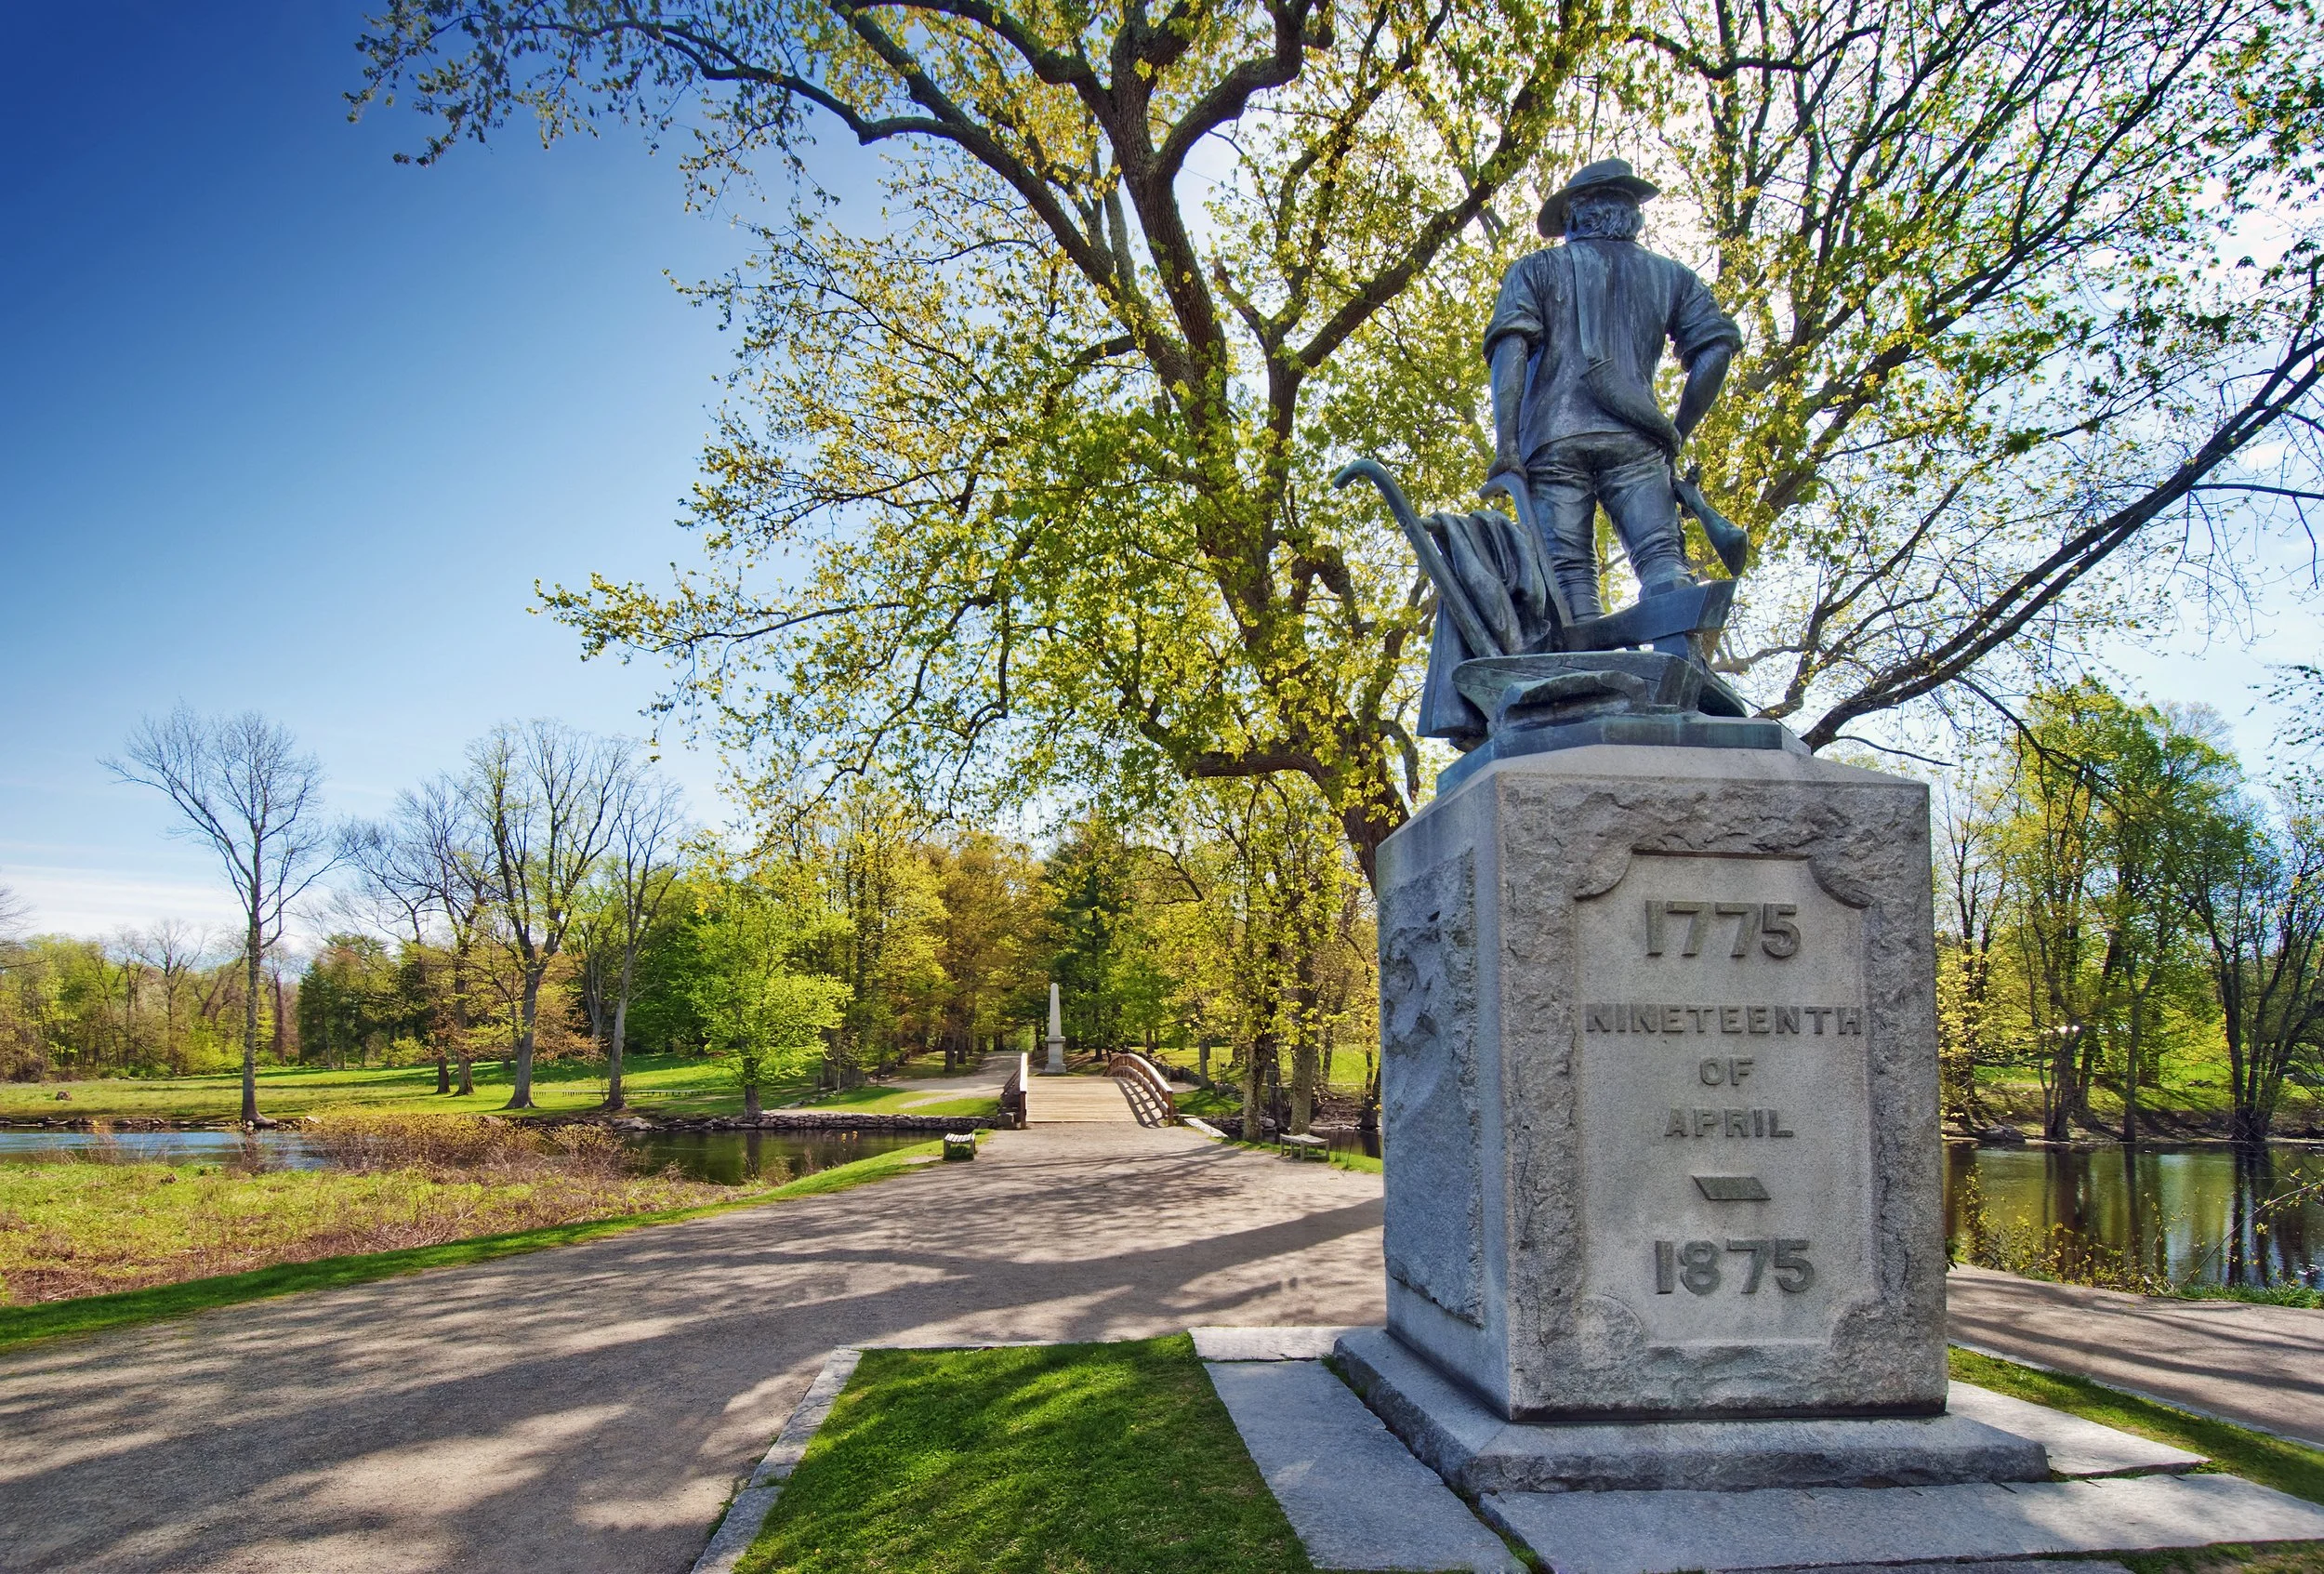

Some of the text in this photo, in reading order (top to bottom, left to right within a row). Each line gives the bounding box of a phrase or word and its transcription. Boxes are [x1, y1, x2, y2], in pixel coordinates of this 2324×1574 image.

[1645, 899, 1802, 959] 1775
[1586, 1003, 1861, 1034] NINETEENTH
[1699, 1056, 1754, 1085] OF
[1664, 1108, 1794, 1137] APRIL
[1655, 1238, 1816, 1295] 1875
